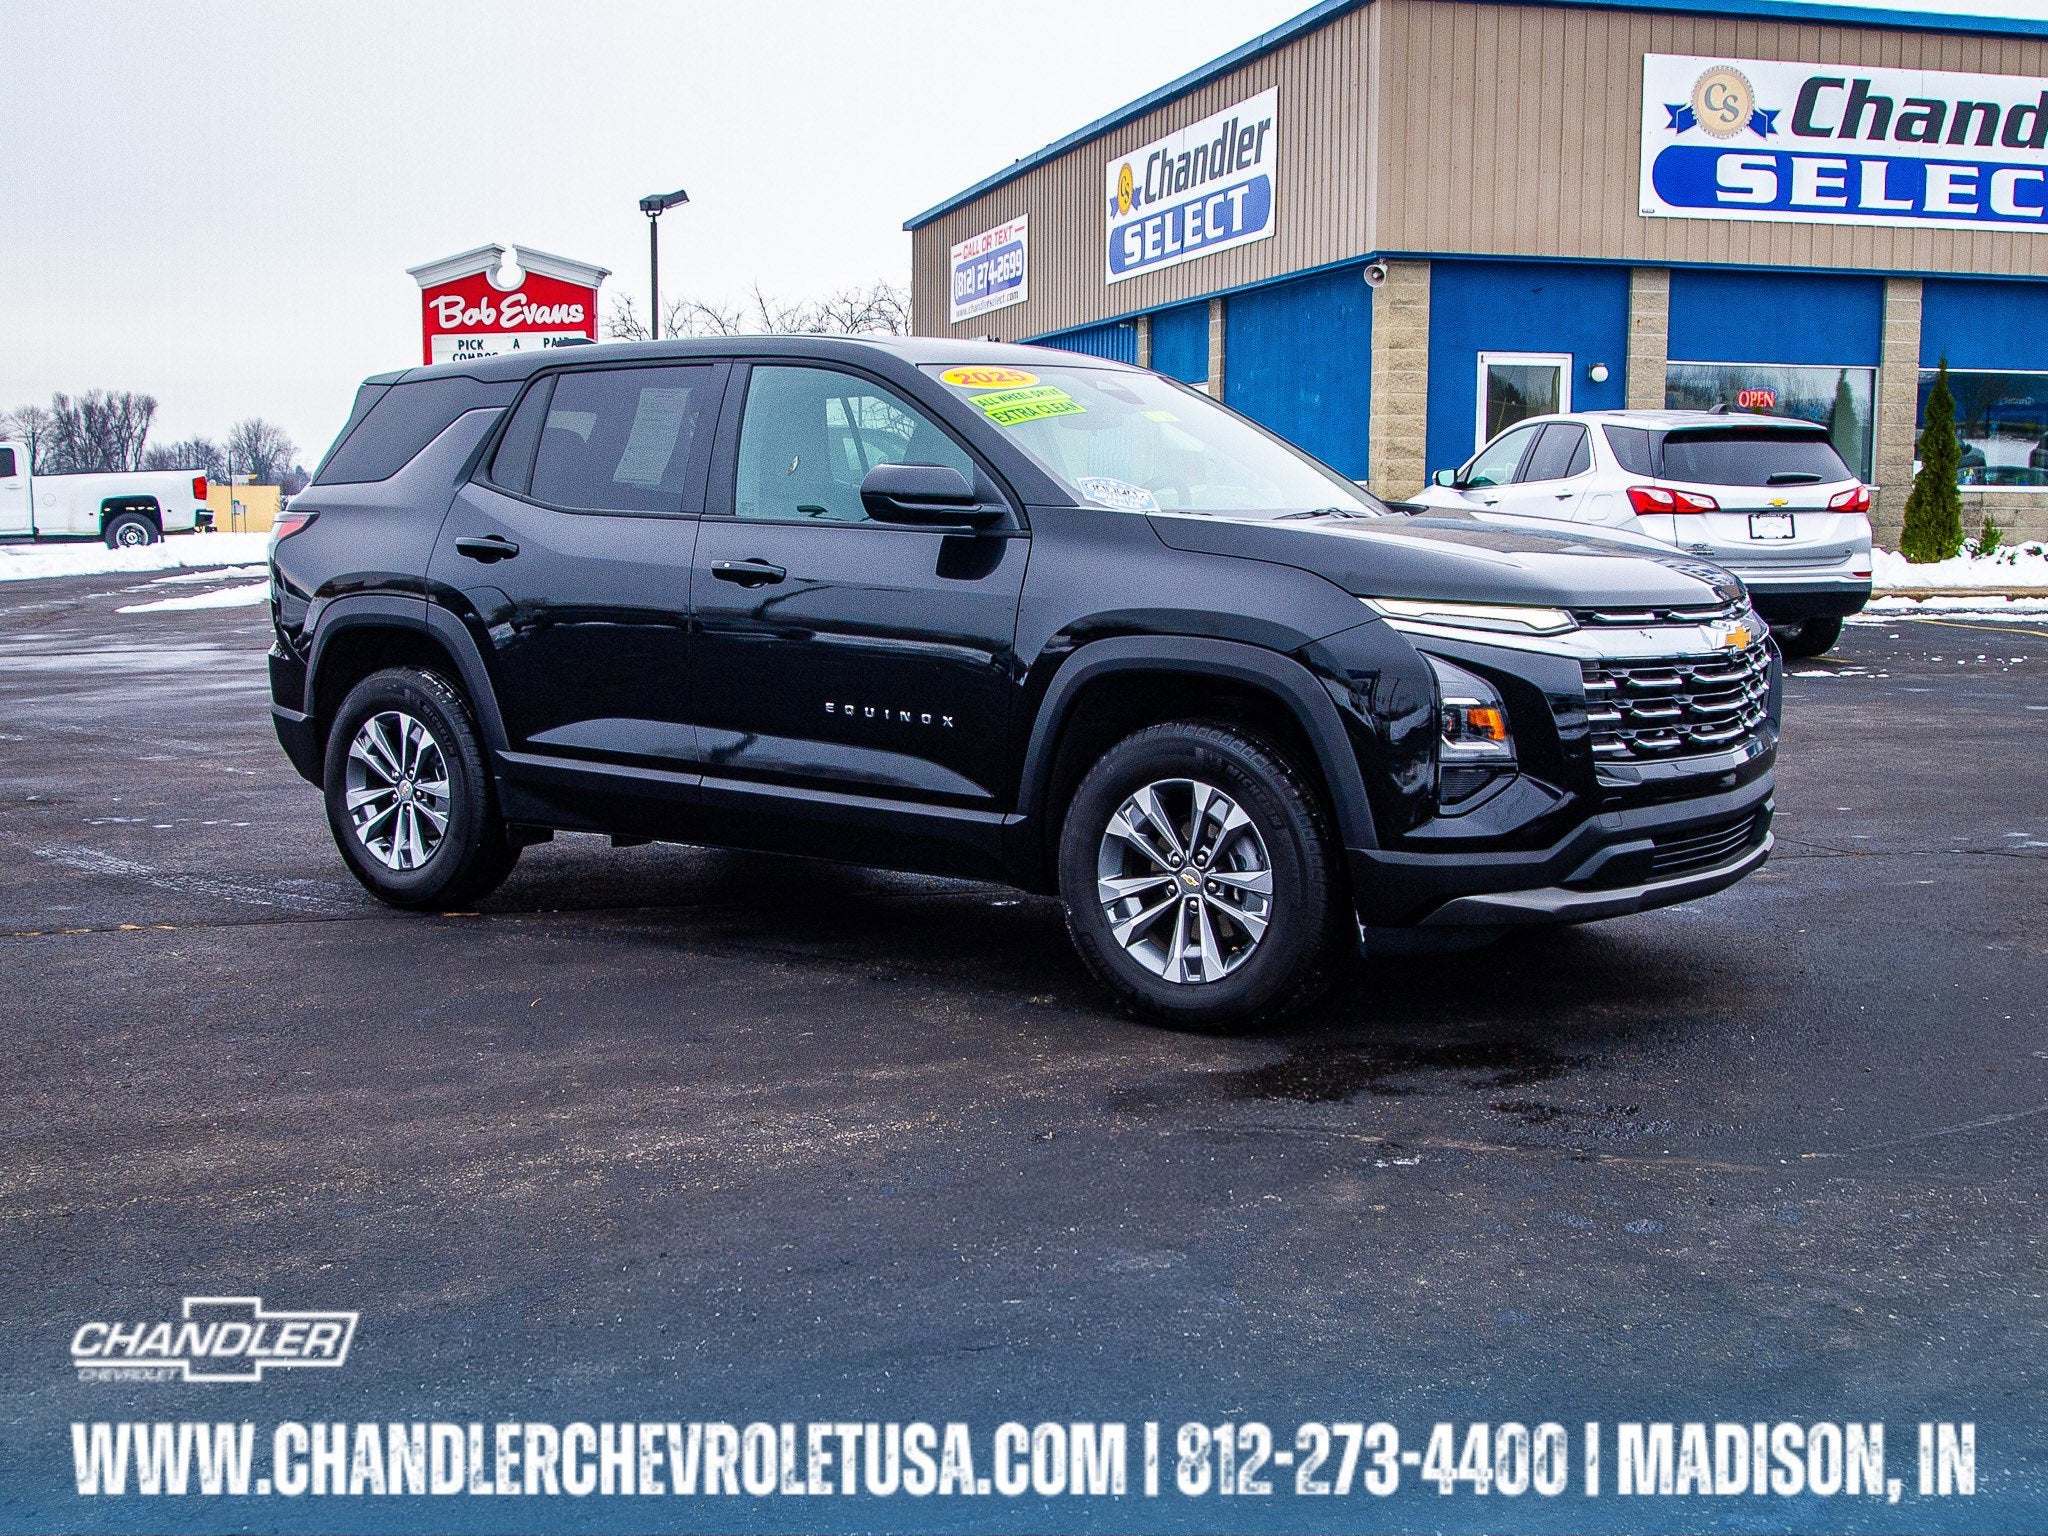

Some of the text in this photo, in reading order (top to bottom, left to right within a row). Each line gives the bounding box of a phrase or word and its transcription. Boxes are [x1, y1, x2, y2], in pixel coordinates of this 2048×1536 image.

[1791, 75, 2048, 149] Chand
[1144, 116, 1272, 205] Chandler
[1715, 153, 2045, 218] SELEC
[962, 225, 1013, 260] CALL OR TEXT
[1123, 183, 1250, 267] SELECT
[955, 248, 1023, 300] (812) 274-2699
[429, 292, 585, 329] Bob Evans
[458, 337, 571, 351] PICK A PA
[953, 370, 1028, 385] 2025
[977, 388, 1063, 407] ALL WHEEL DRIVE
[991, 400, 1078, 423] EXTRA CLEAN
[1738, 390, 1775, 408] OPEN
[825, 702, 954, 728] EQUINOX
